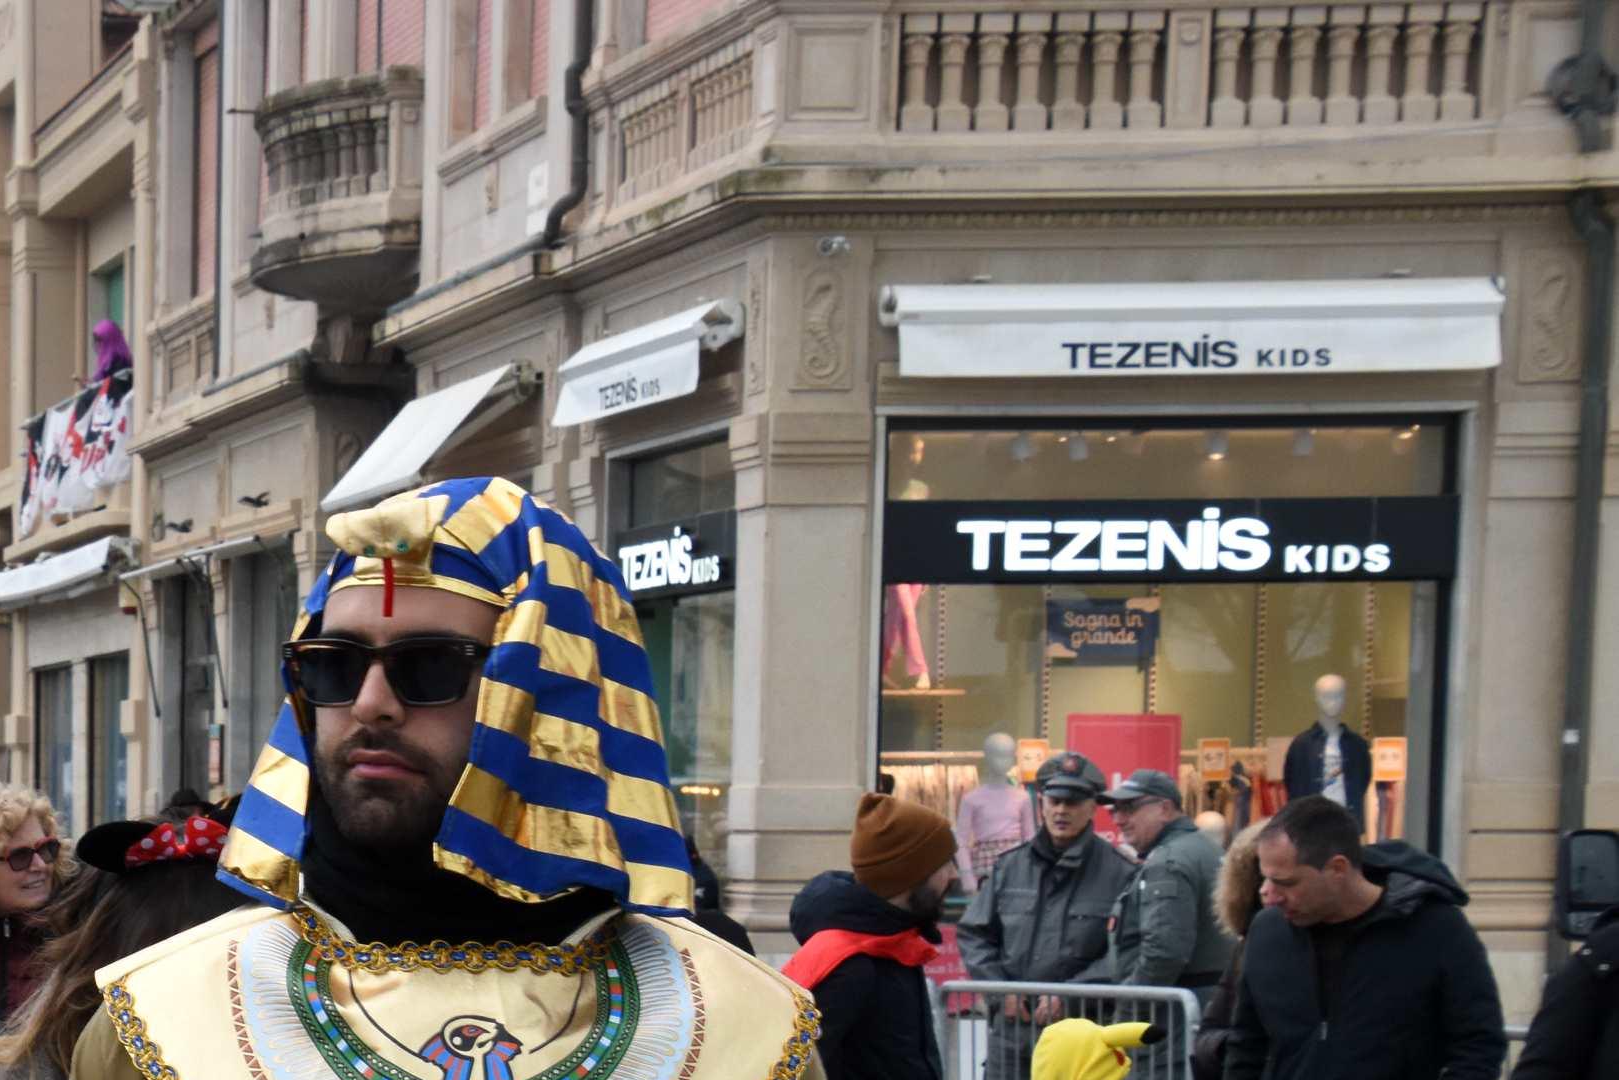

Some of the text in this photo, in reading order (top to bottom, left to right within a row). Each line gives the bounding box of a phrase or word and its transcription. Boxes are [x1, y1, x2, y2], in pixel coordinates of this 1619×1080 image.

[1257, 349, 1331, 367] KIDS
[641, 378, 661, 398] KIDS
[1283, 544, 1391, 573] KIDS
[691, 555, 720, 584] KIDS
[1124, 608, 1144, 628] in
[1070, 627, 1138, 649] grande
